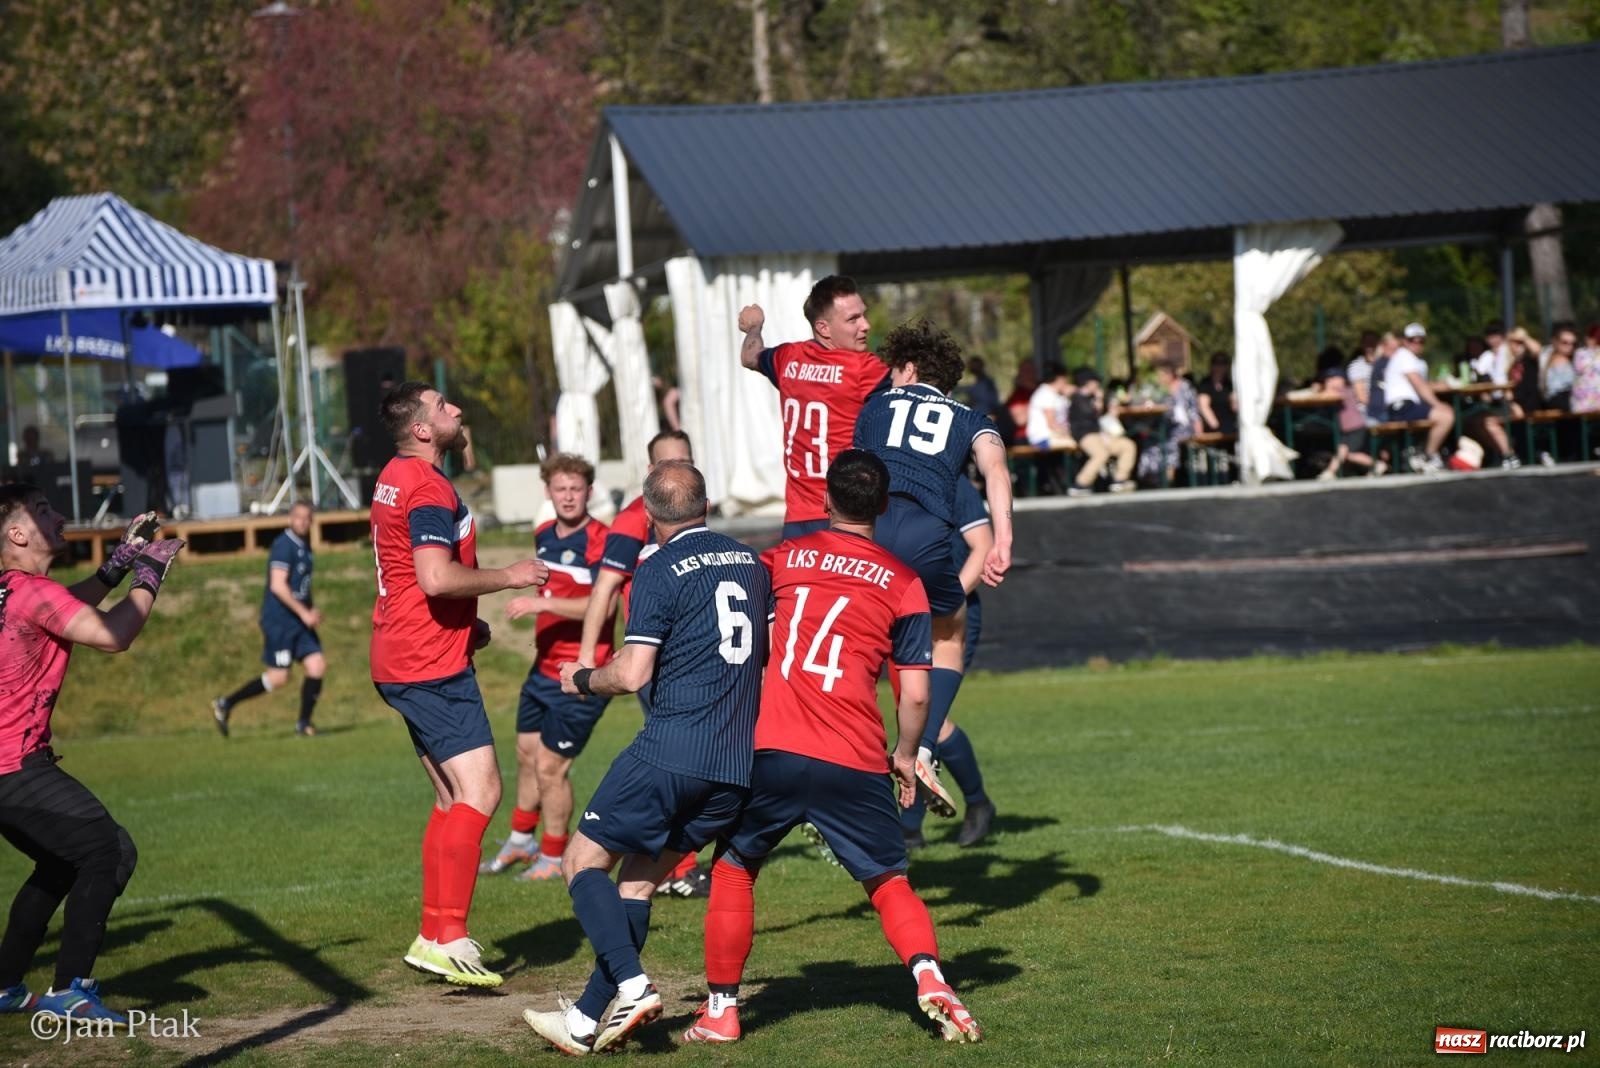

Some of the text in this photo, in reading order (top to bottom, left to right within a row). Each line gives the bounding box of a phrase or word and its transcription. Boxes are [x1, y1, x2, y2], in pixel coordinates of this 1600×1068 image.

[798, 363, 844, 384] BRZEZIE
[784, 398, 829, 478] 23
[886, 399, 954, 456] 19
[671, 556, 701, 577] LKS
[786, 549, 895, 590] LKS BRZEZIE
[715, 581, 753, 665] 6
[780, 586, 850, 693] 14
